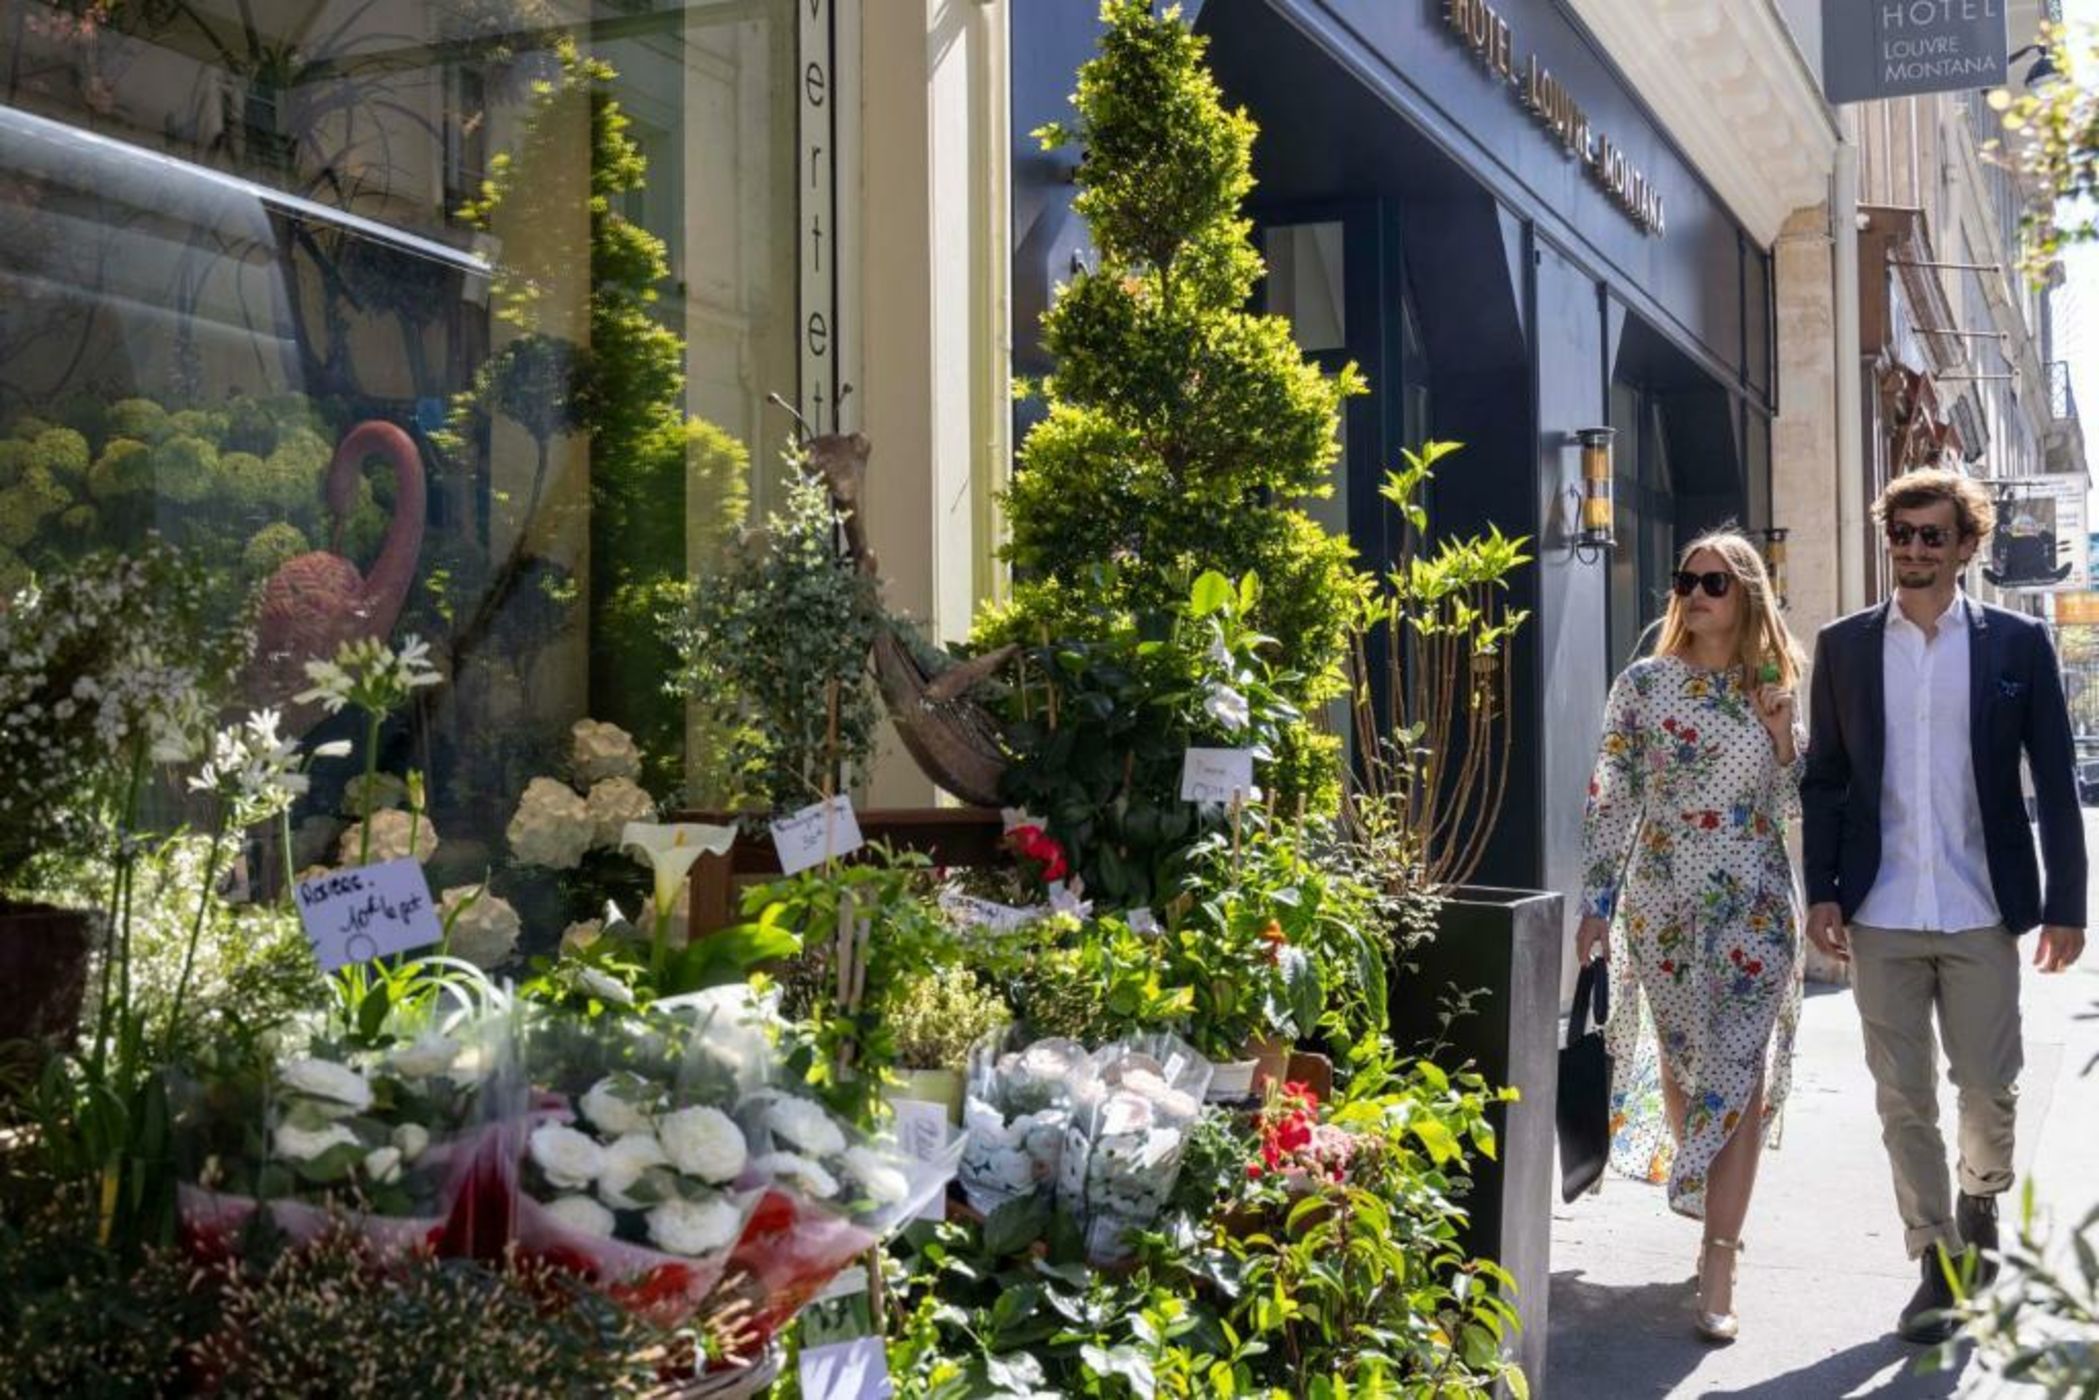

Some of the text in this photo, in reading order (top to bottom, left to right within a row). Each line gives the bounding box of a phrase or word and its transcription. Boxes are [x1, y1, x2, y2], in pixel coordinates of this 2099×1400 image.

[1883, 0, 1996, 29] HOTEL
[1883, 36, 1960, 60] LOUVRE
[1884, 55, 1997, 82] MONTANA
